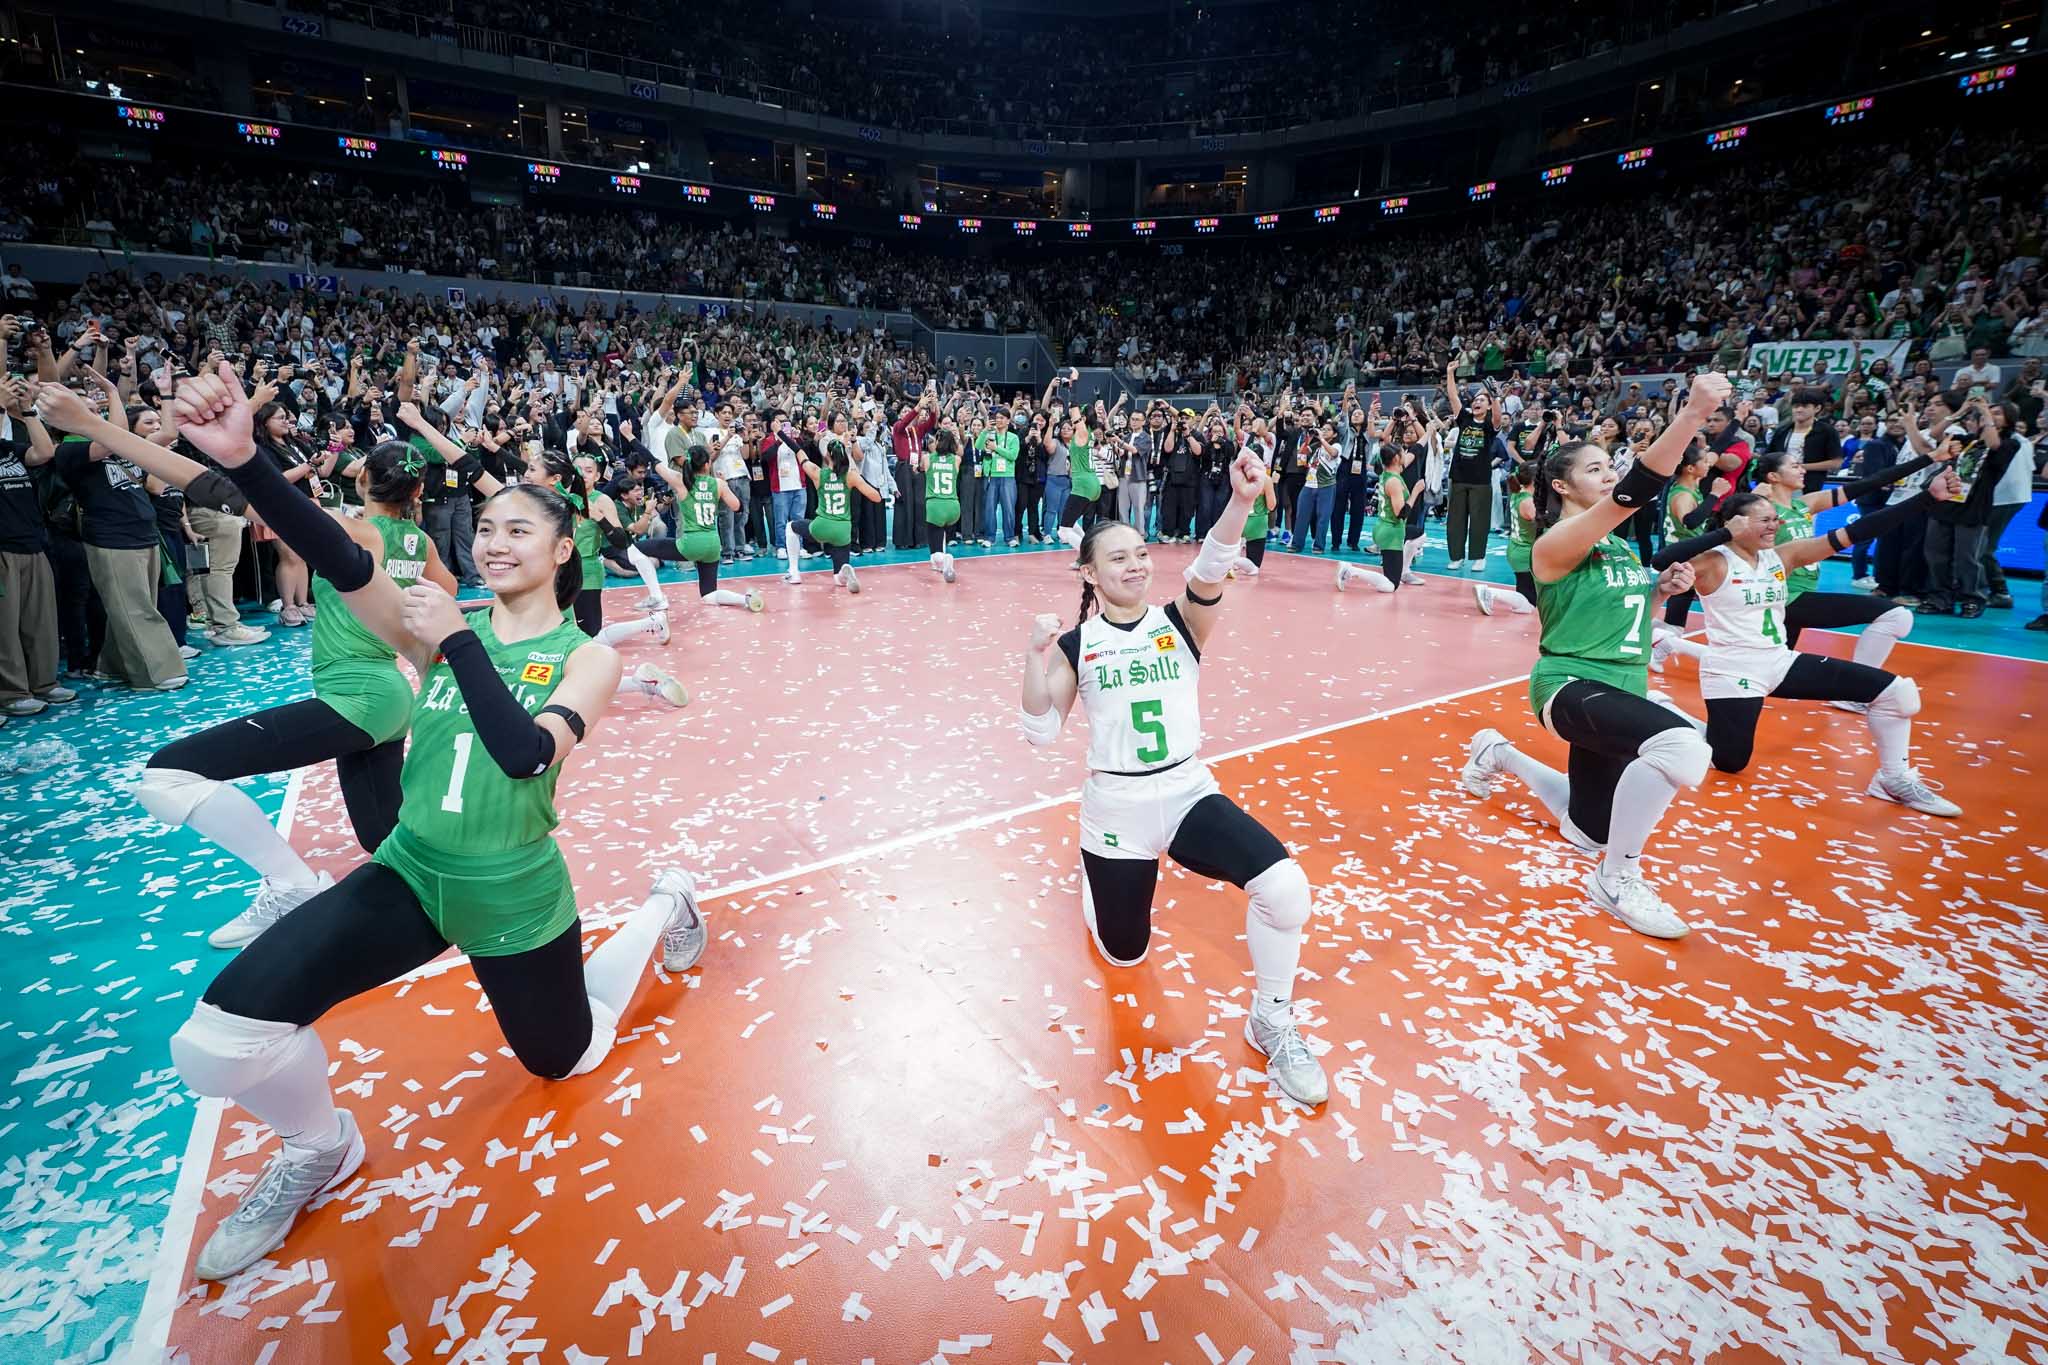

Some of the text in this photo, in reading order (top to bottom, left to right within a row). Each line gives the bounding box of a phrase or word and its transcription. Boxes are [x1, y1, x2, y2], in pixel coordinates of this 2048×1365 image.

[282, 16, 321, 38] 422
[1959, 64, 2016, 88] CASINO
[631, 80, 657, 100] 401
[1966, 81, 2004, 96] PLUS
[118, 106, 165, 122] CASINO
[1825, 97, 1873, 118] CASINO
[127, 119, 159, 130] PLUS
[1831, 112, 1864, 125] PLUS
[238, 123, 280, 137] CASINO
[1707, 127, 1748, 144] CASINO
[246, 135, 275, 145] PLUS
[338, 137, 377, 151] CASINO
[1712, 139, 1740, 151] PLUS
[345, 149, 373, 159] PLUS
[933, 472, 953, 495] 15
[824, 493, 846, 515] 12
[694, 502, 715, 526] 10
[1602, 565, 1625, 588] La
[1623, 594, 1646, 643] 7
[1761, 608, 1783, 645] 4
[1157, 635, 1174, 647] F2
[526, 664, 551, 679] F2
[1095, 655, 1180, 691] La Salle
[1738, 678, 1749, 689] 4
[421, 675, 457, 711] La
[1130, 699, 1170, 764] 5
[440, 732, 474, 814] 1
[1103, 832, 1119, 848] 5
